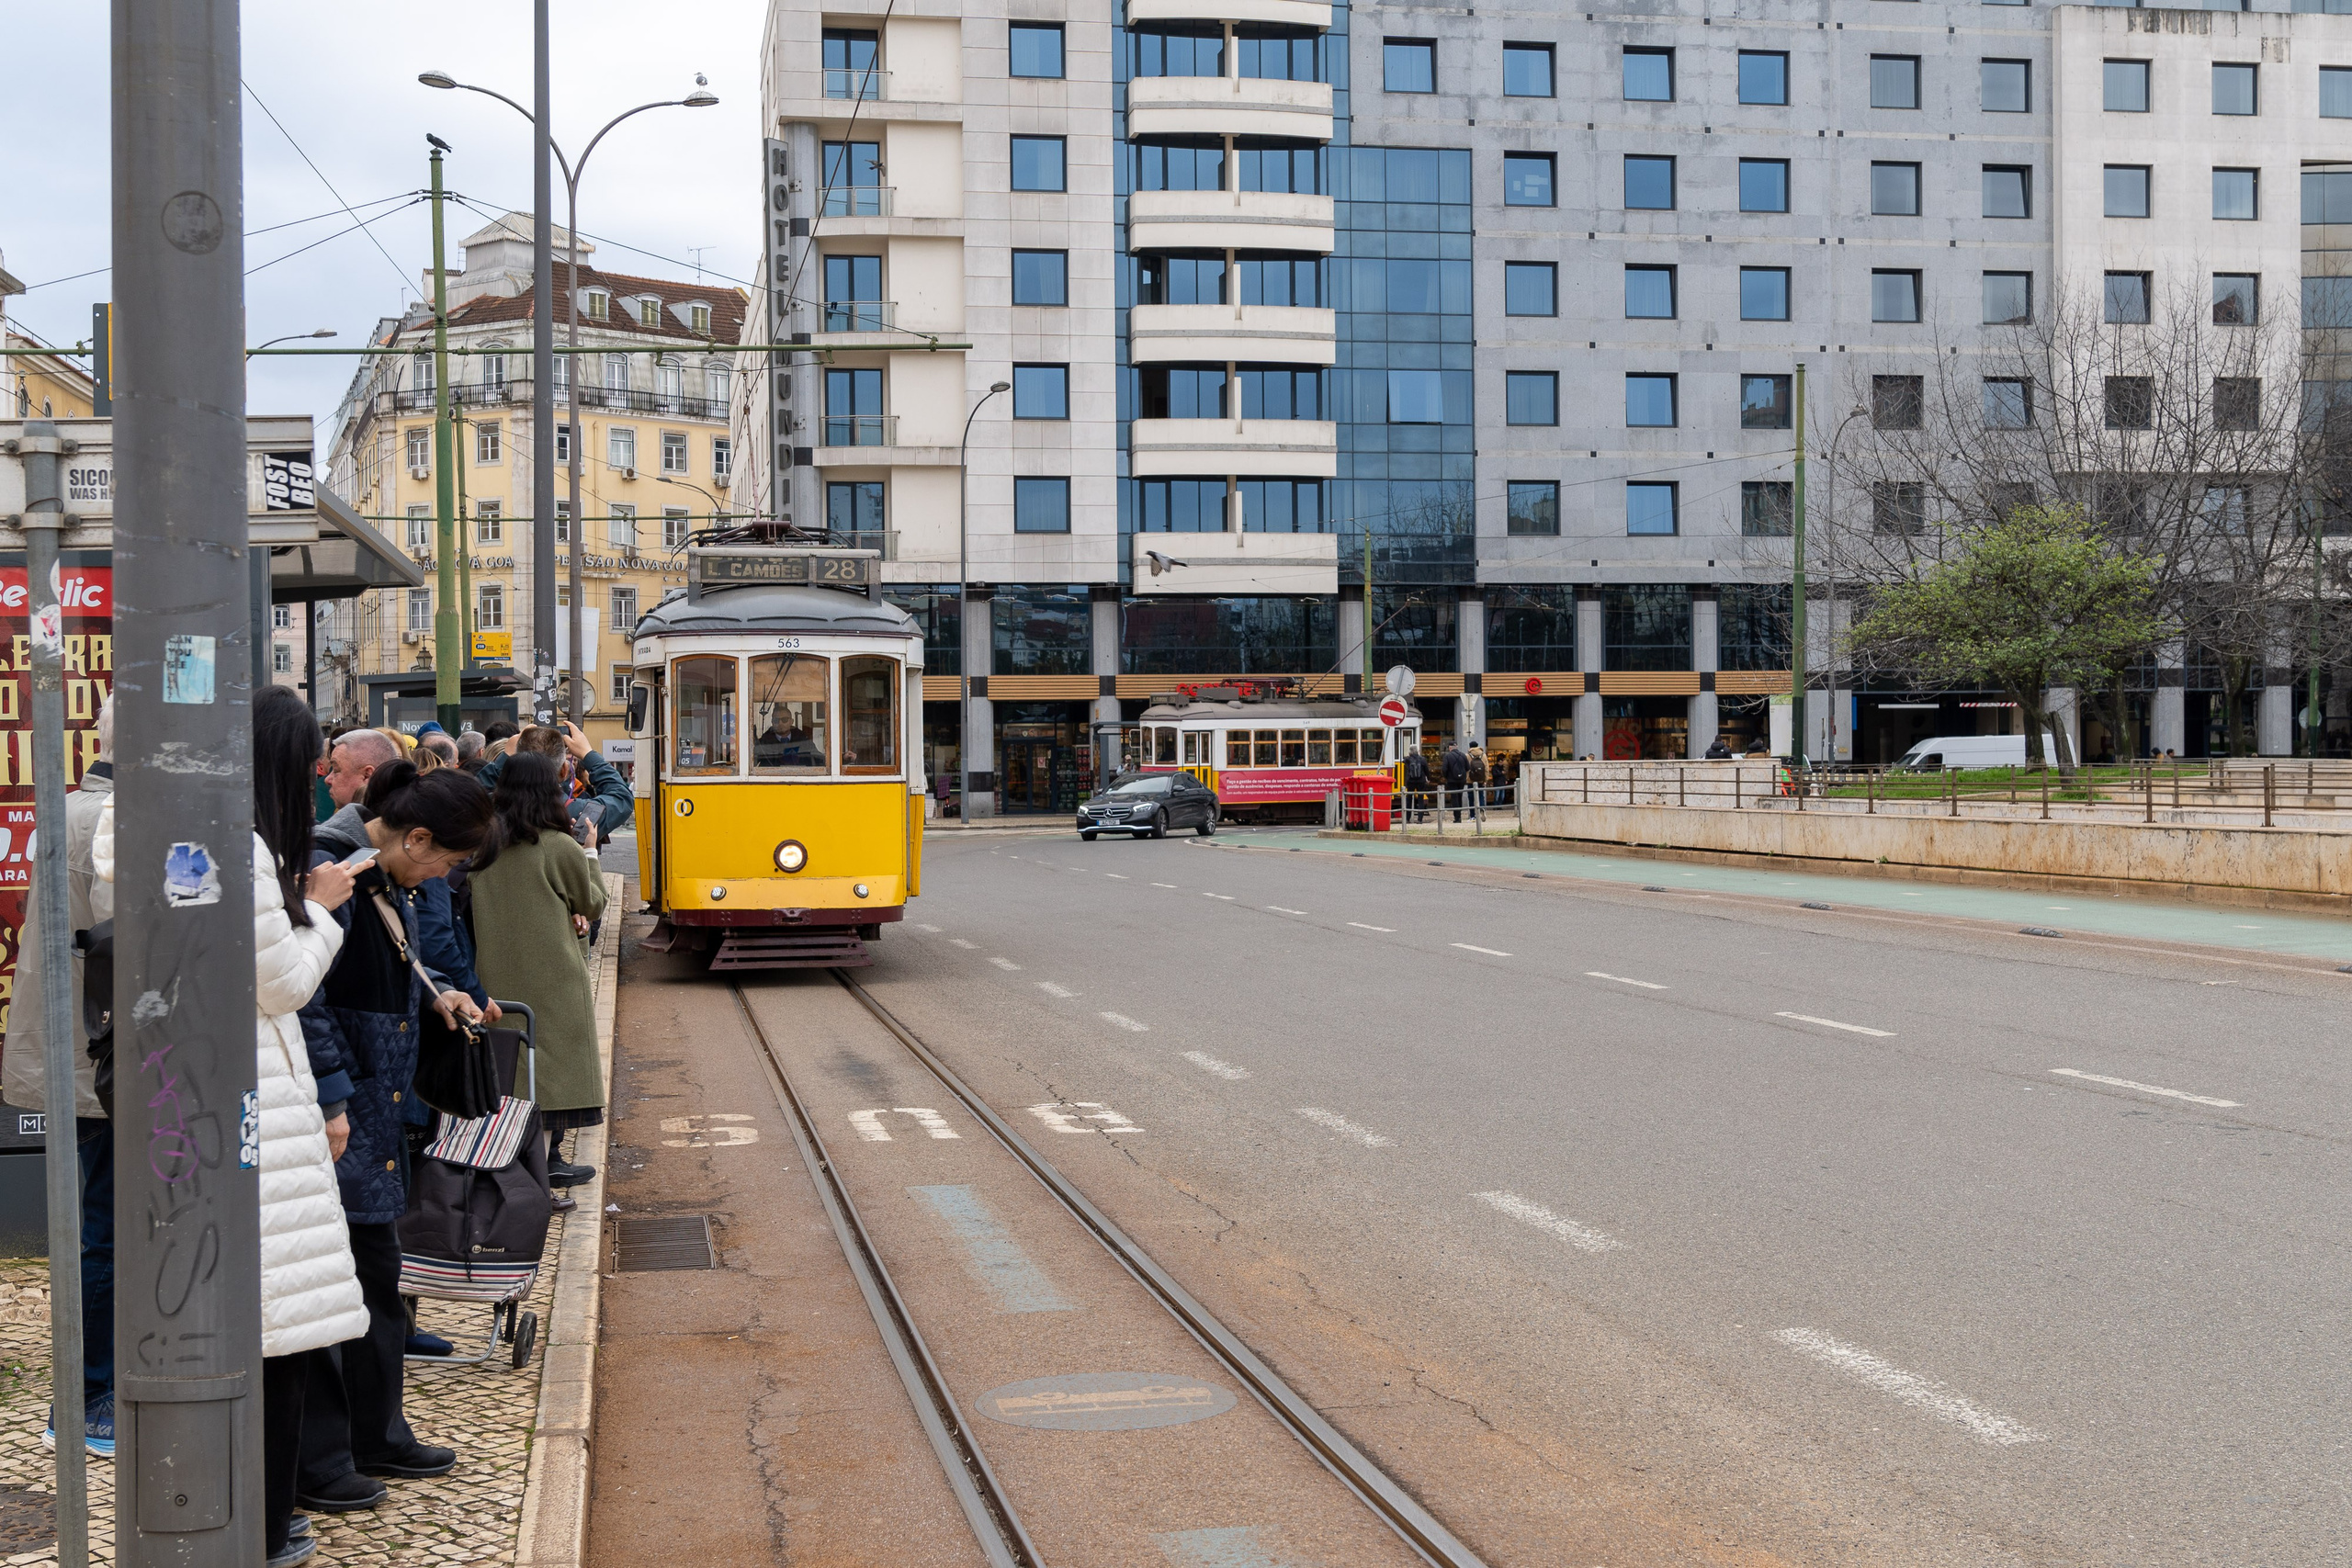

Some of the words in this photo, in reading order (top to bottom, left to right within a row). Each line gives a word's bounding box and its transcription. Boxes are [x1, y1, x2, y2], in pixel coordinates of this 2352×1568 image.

[773, 148, 789, 317] HOTEL
[70, 469, 112, 486] SICO
[265, 454, 290, 509] FOST
[288, 461, 315, 505] BEO
[70, 488, 96, 500] WAS
[100, 488, 112, 500] H
[486, 556, 514, 568] GOA
[618, 557, 661, 570] NOVA
[662, 560, 688, 571] GO
[730, 560, 804, 578] CAMÕES
[824, 559, 856, 580] 28
[777, 637, 800, 649] 563
[612, 745, 633, 753] Kamal
[681, 757, 691, 765] 05
